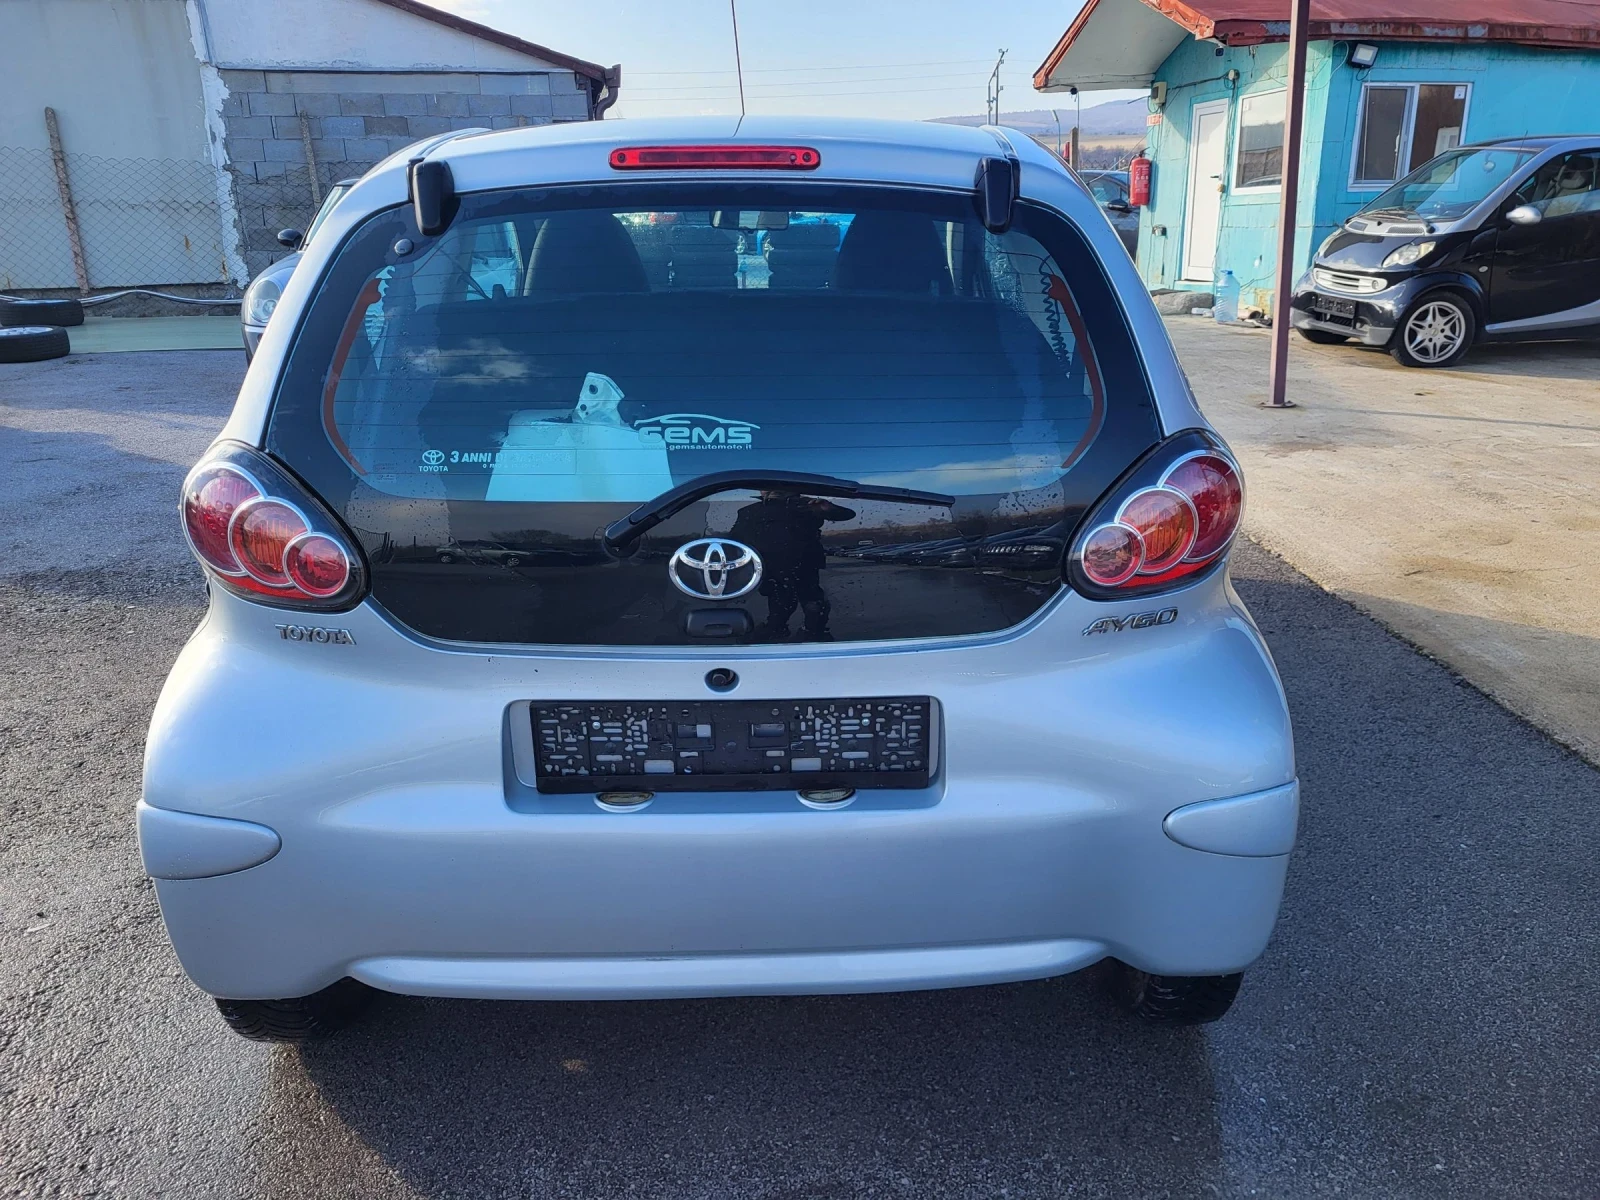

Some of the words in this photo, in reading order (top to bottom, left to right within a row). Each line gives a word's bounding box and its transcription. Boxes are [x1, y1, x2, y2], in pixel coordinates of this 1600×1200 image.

[450, 451, 460, 463] 3
[461, 452, 492, 463] ANNI
[1082, 606, 1178, 636] AYGO
[274, 623, 357, 645] TOYOTA
